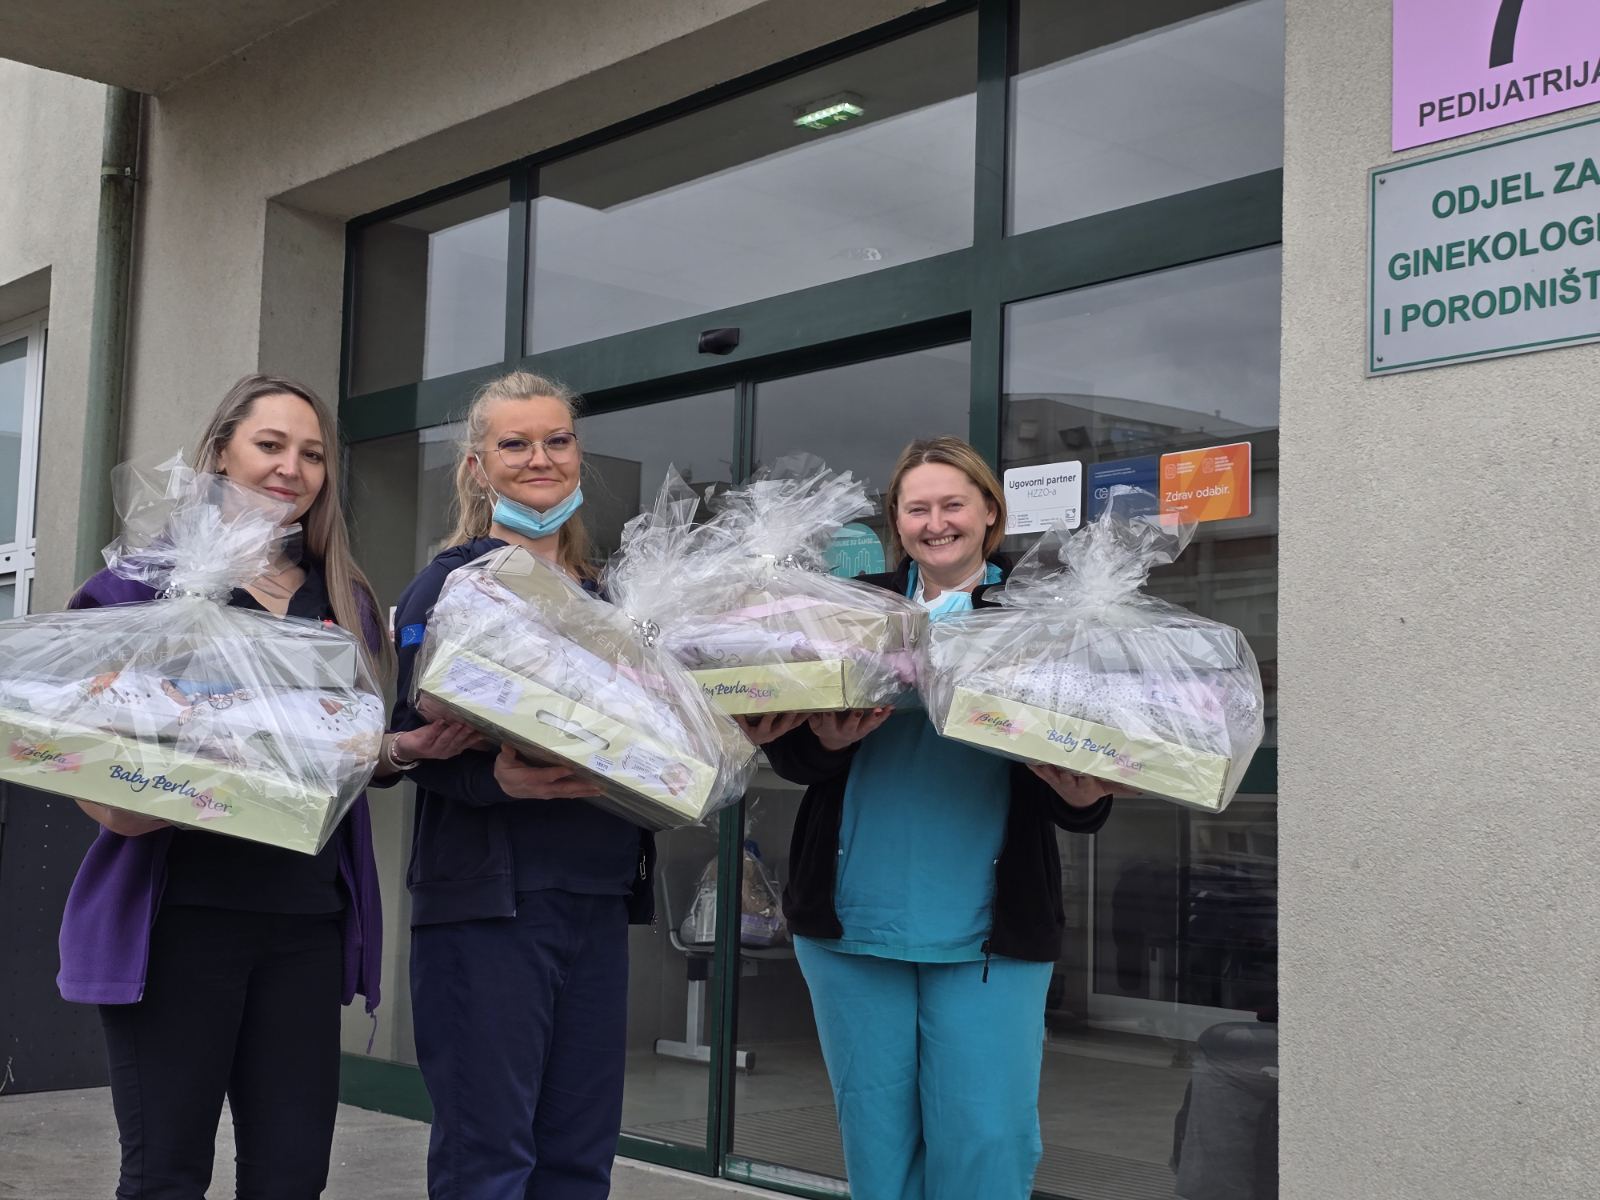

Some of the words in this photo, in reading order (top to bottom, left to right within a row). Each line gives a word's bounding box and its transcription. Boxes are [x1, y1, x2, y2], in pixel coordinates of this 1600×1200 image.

[1432, 172, 1544, 219] ODJEL
[1553, 157, 1600, 194] ZA
[1384, 308, 1391, 335] I
[1402, 267, 1600, 332] PORODNIŠT
[1009, 477, 1044, 490] Ugovorni
[1046, 475, 1076, 487] partner
[1027, 488, 1057, 498] HZZO-a
[1165, 491, 1193, 502] Zdrav
[1195, 485, 1230, 498] odabir.
[715, 681, 750, 696] Perla
[1047, 729, 1079, 752] Baby
[1081, 738, 1119, 758] Perla
[109, 764, 149, 792] Baby
[152, 775, 200, 798] Perla
[196, 795, 232, 813] Ster
